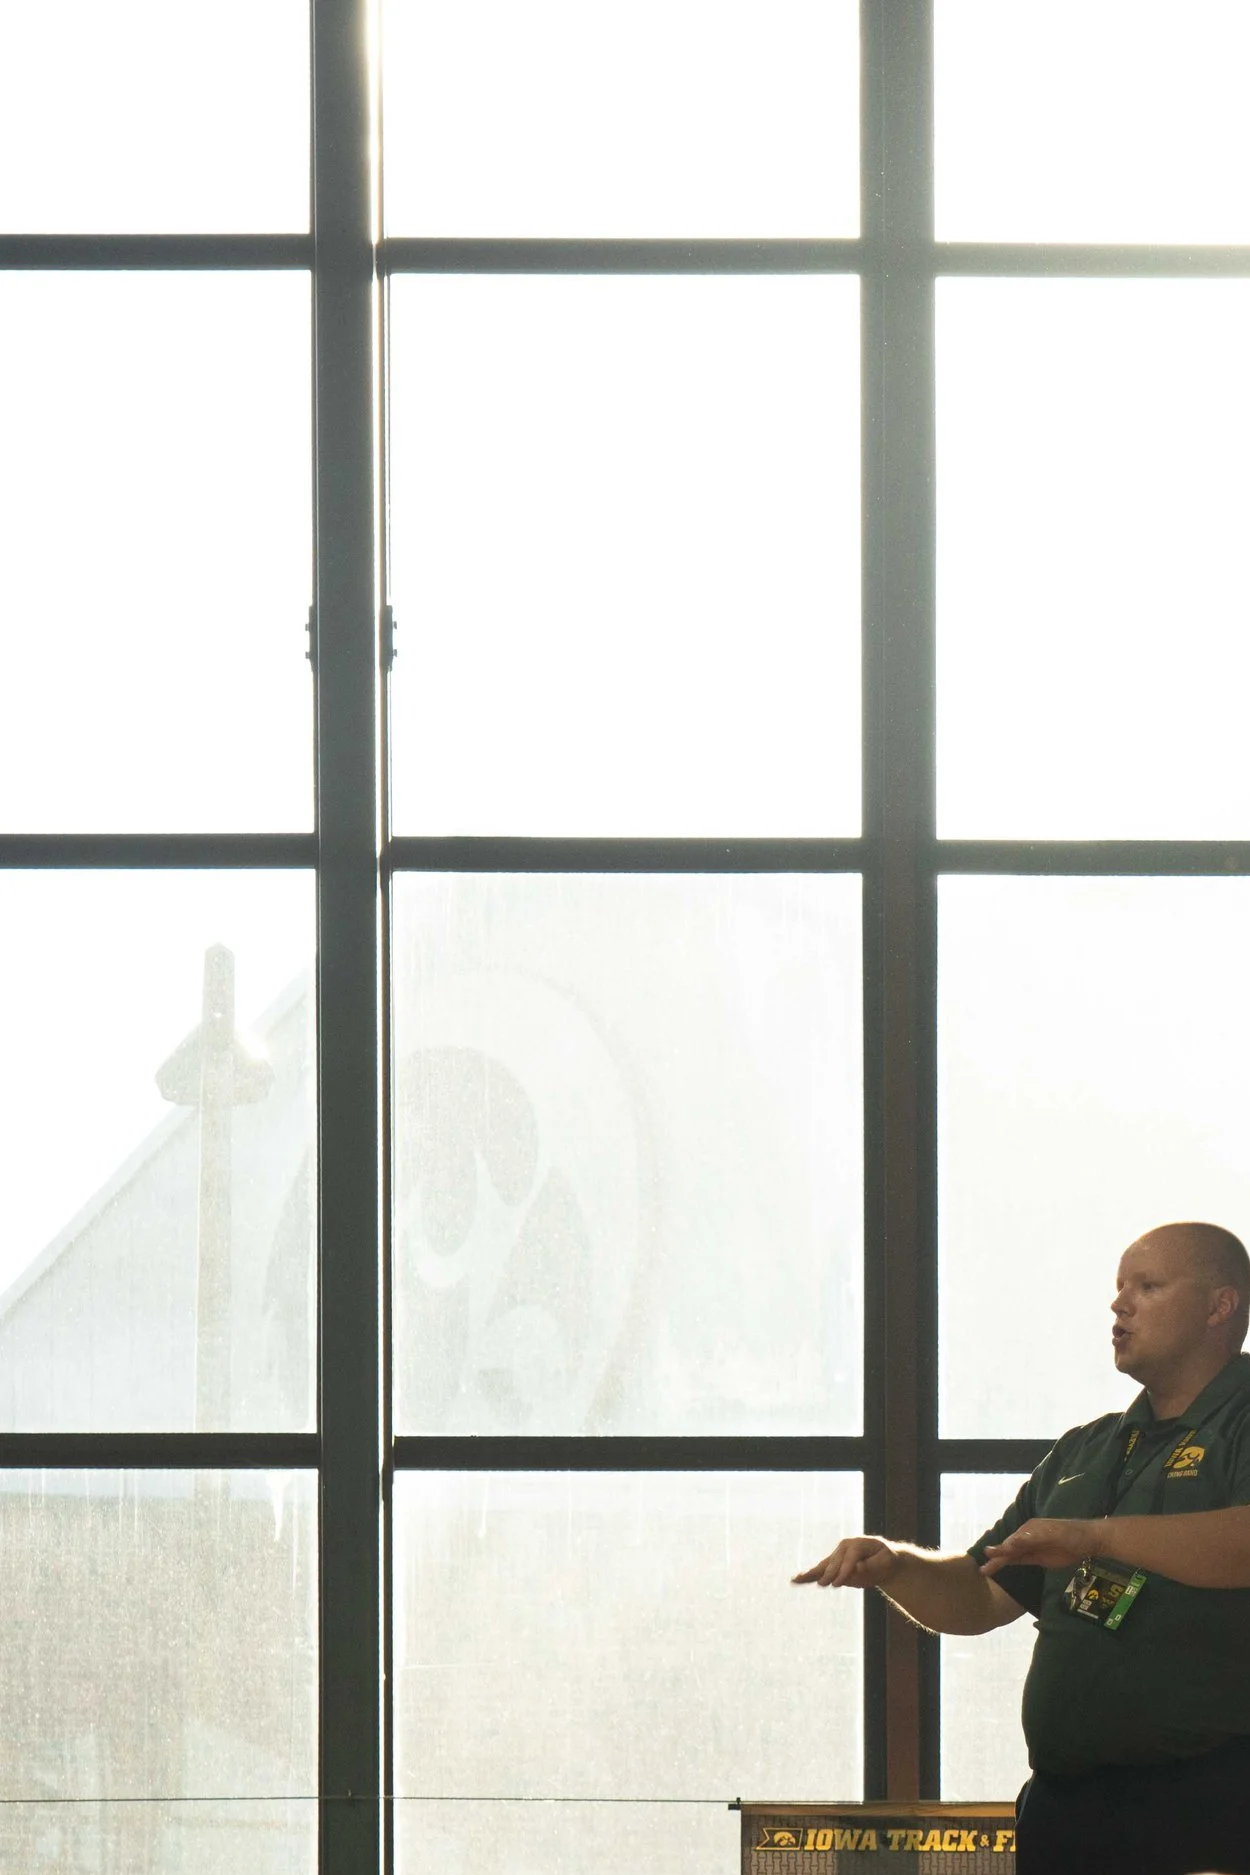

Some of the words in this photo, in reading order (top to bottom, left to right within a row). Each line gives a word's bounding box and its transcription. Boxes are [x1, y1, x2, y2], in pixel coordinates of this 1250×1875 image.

[804, 1830, 877, 1851] IOWA
[887, 1830, 978, 1852] TRACK
[980, 1834, 990, 1847] &
